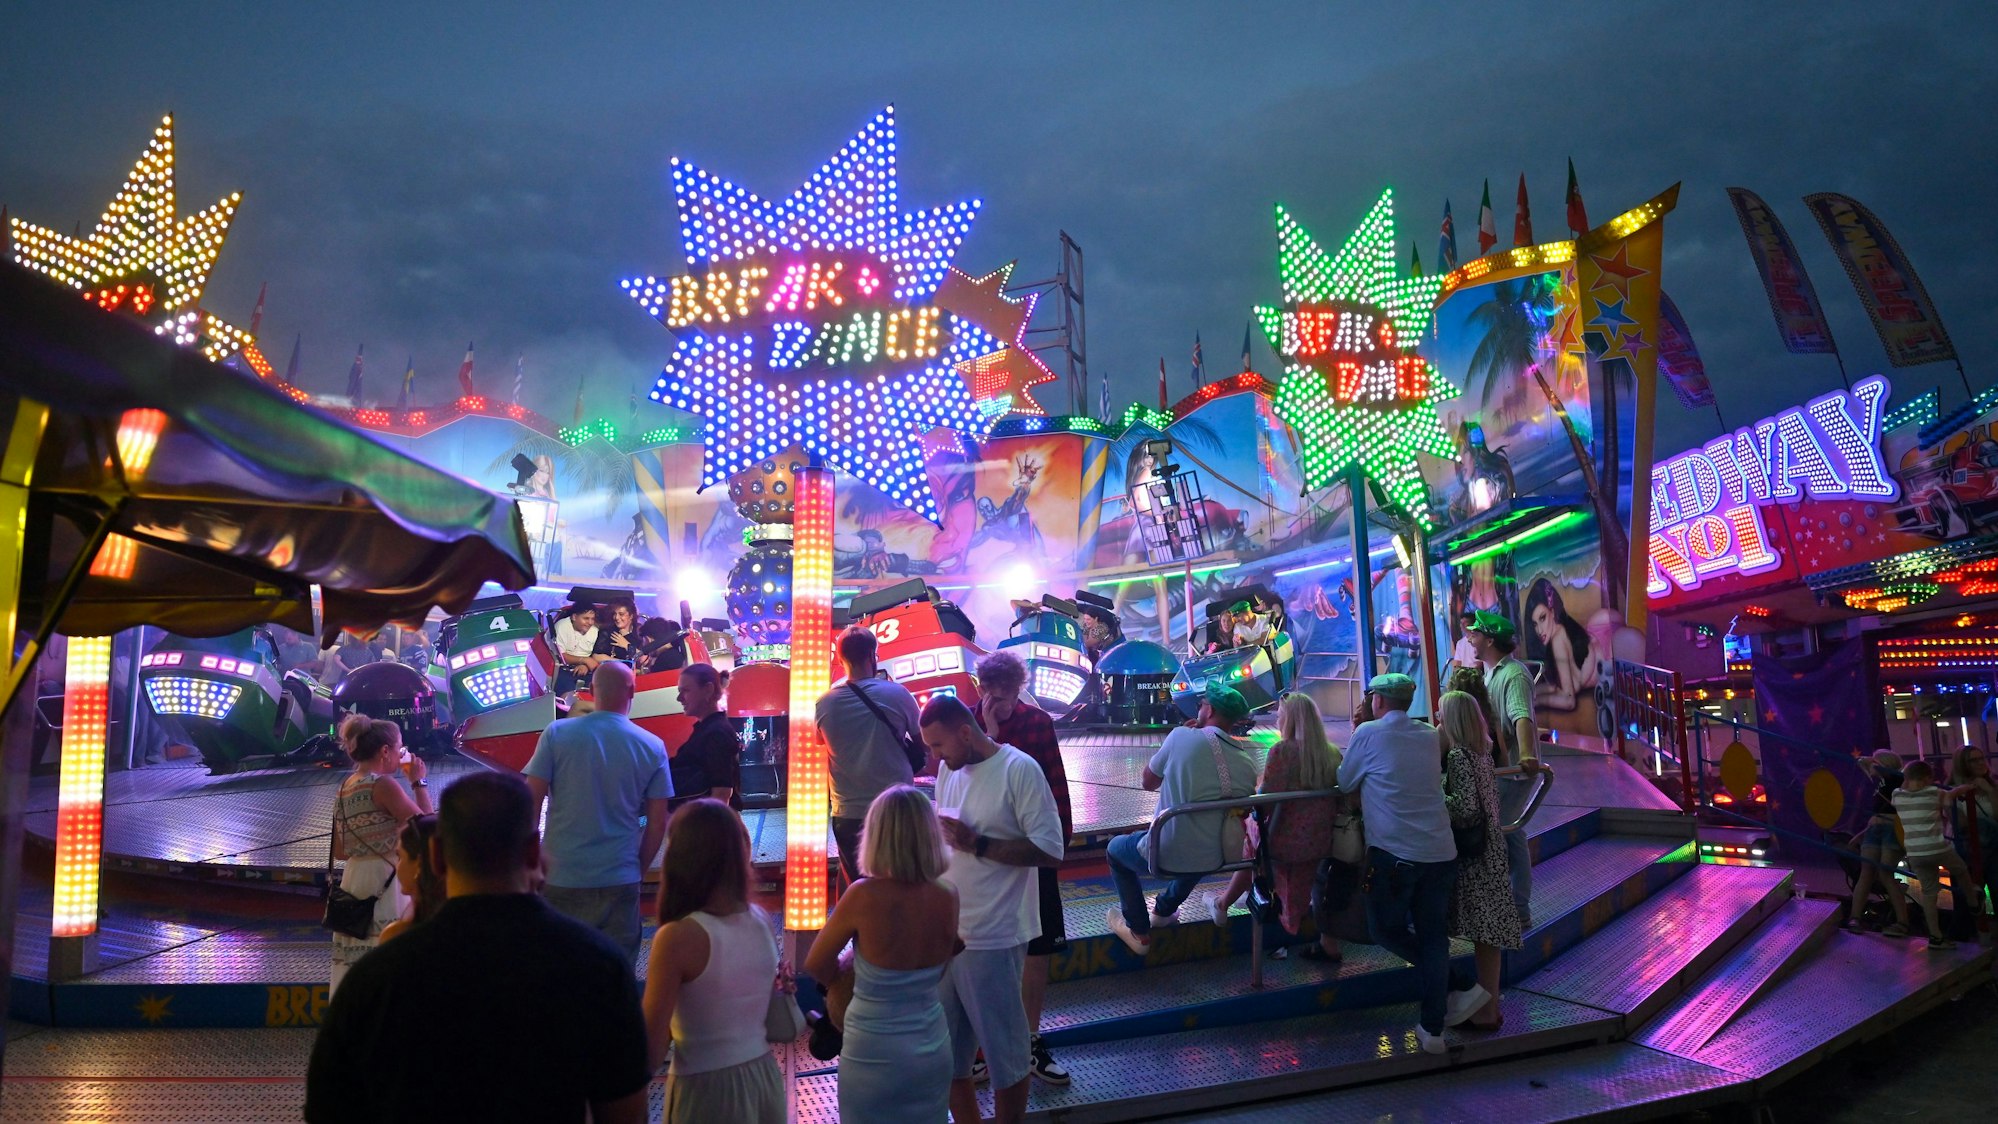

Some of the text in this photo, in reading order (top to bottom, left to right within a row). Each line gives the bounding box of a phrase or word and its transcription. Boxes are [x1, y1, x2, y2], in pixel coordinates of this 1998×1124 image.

[1826, 199, 1927, 322] SPEEDWAY
[667, 260, 846, 328] BREAK
[768, 305, 942, 369] DANCE
[1281, 310, 1376, 356] BREAK
[1336, 355, 1428, 403] DANCE
[489, 615, 510, 631] 4
[1065, 622, 1076, 640] 9
[1137, 681, 1161, 690] BREAK
[388, 707, 415, 716] BREAK
